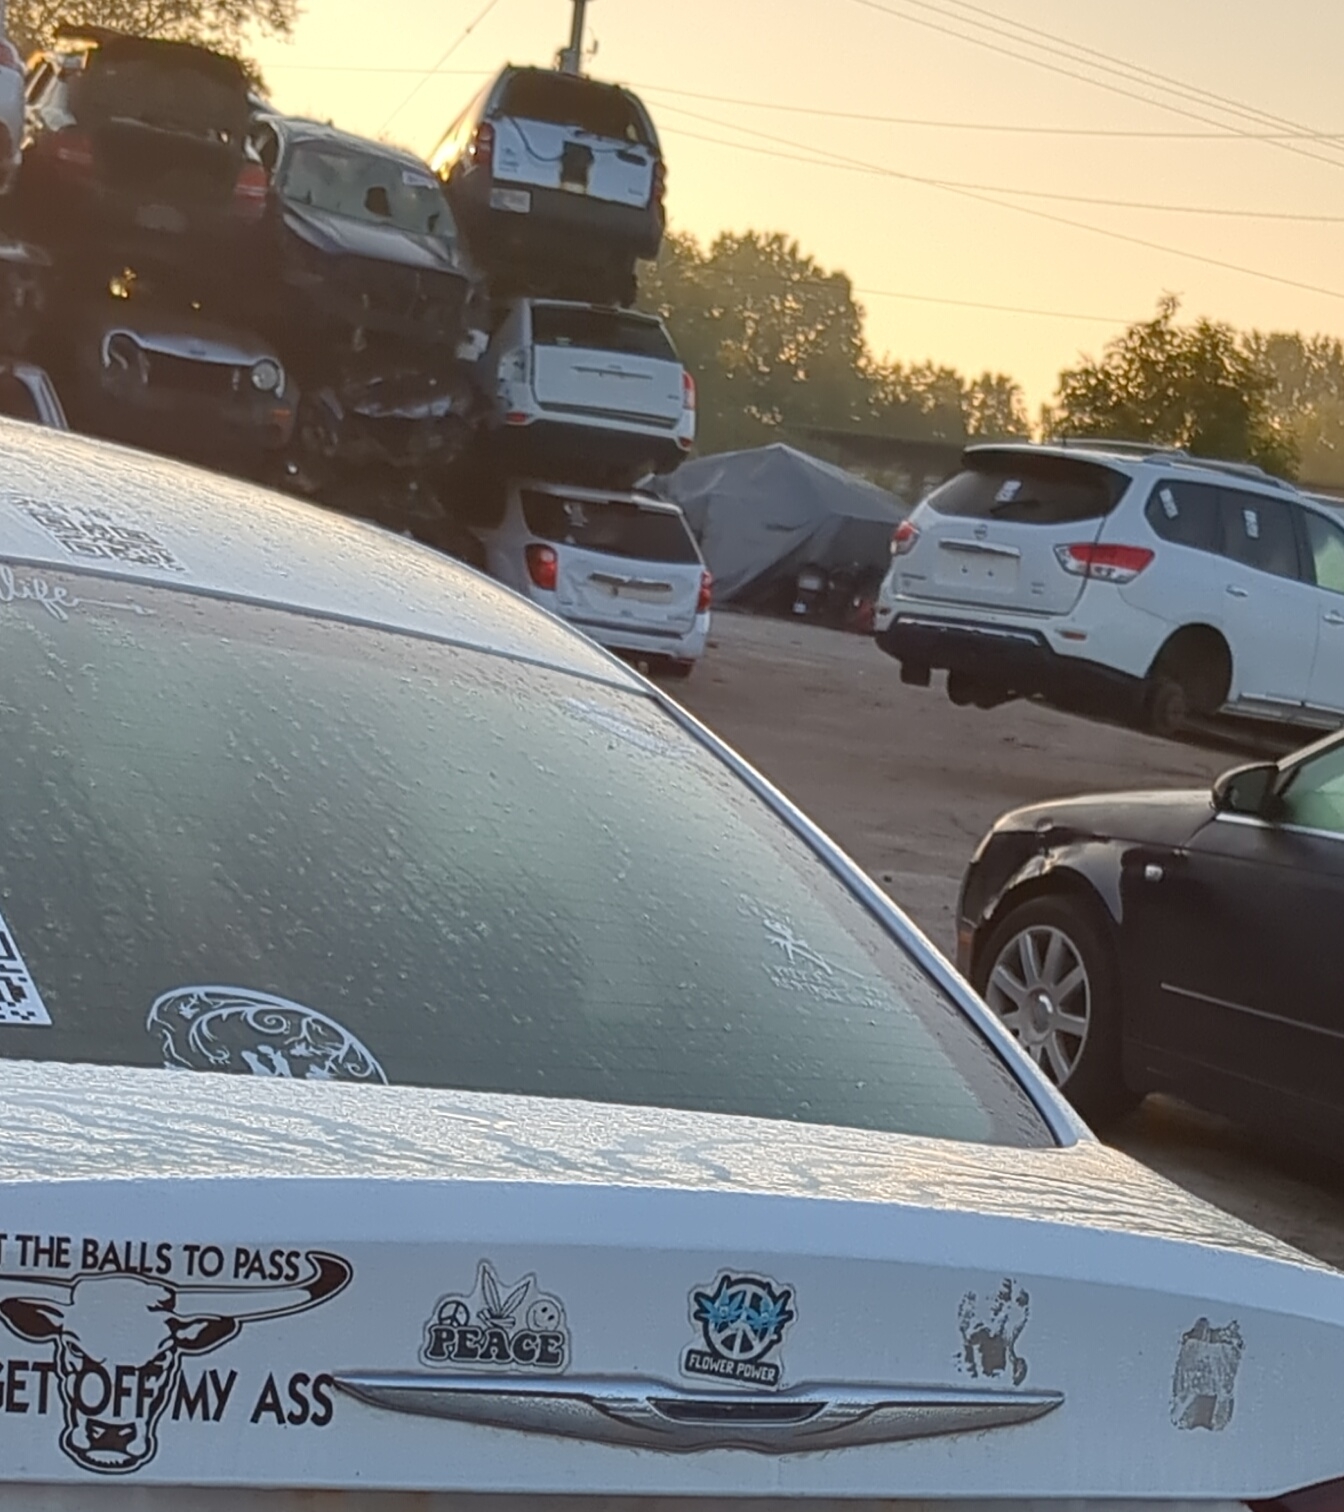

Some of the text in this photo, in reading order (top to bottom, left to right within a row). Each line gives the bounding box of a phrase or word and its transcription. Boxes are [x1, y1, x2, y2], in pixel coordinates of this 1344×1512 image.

[14, 1234, 72, 1269] THE
[80, 1238, 173, 1275] BALLS
[182, 1244, 225, 1278] TO
[232, 1247, 301, 1282] PASS
[425, 1324, 565, 1368] PEACE
[688, 1353, 776, 1382] FLOWER POWER
[73, 1363, 164, 1419] OFF
[171, 1368, 238, 1423] MY
[249, 1371, 336, 1427] ASS
